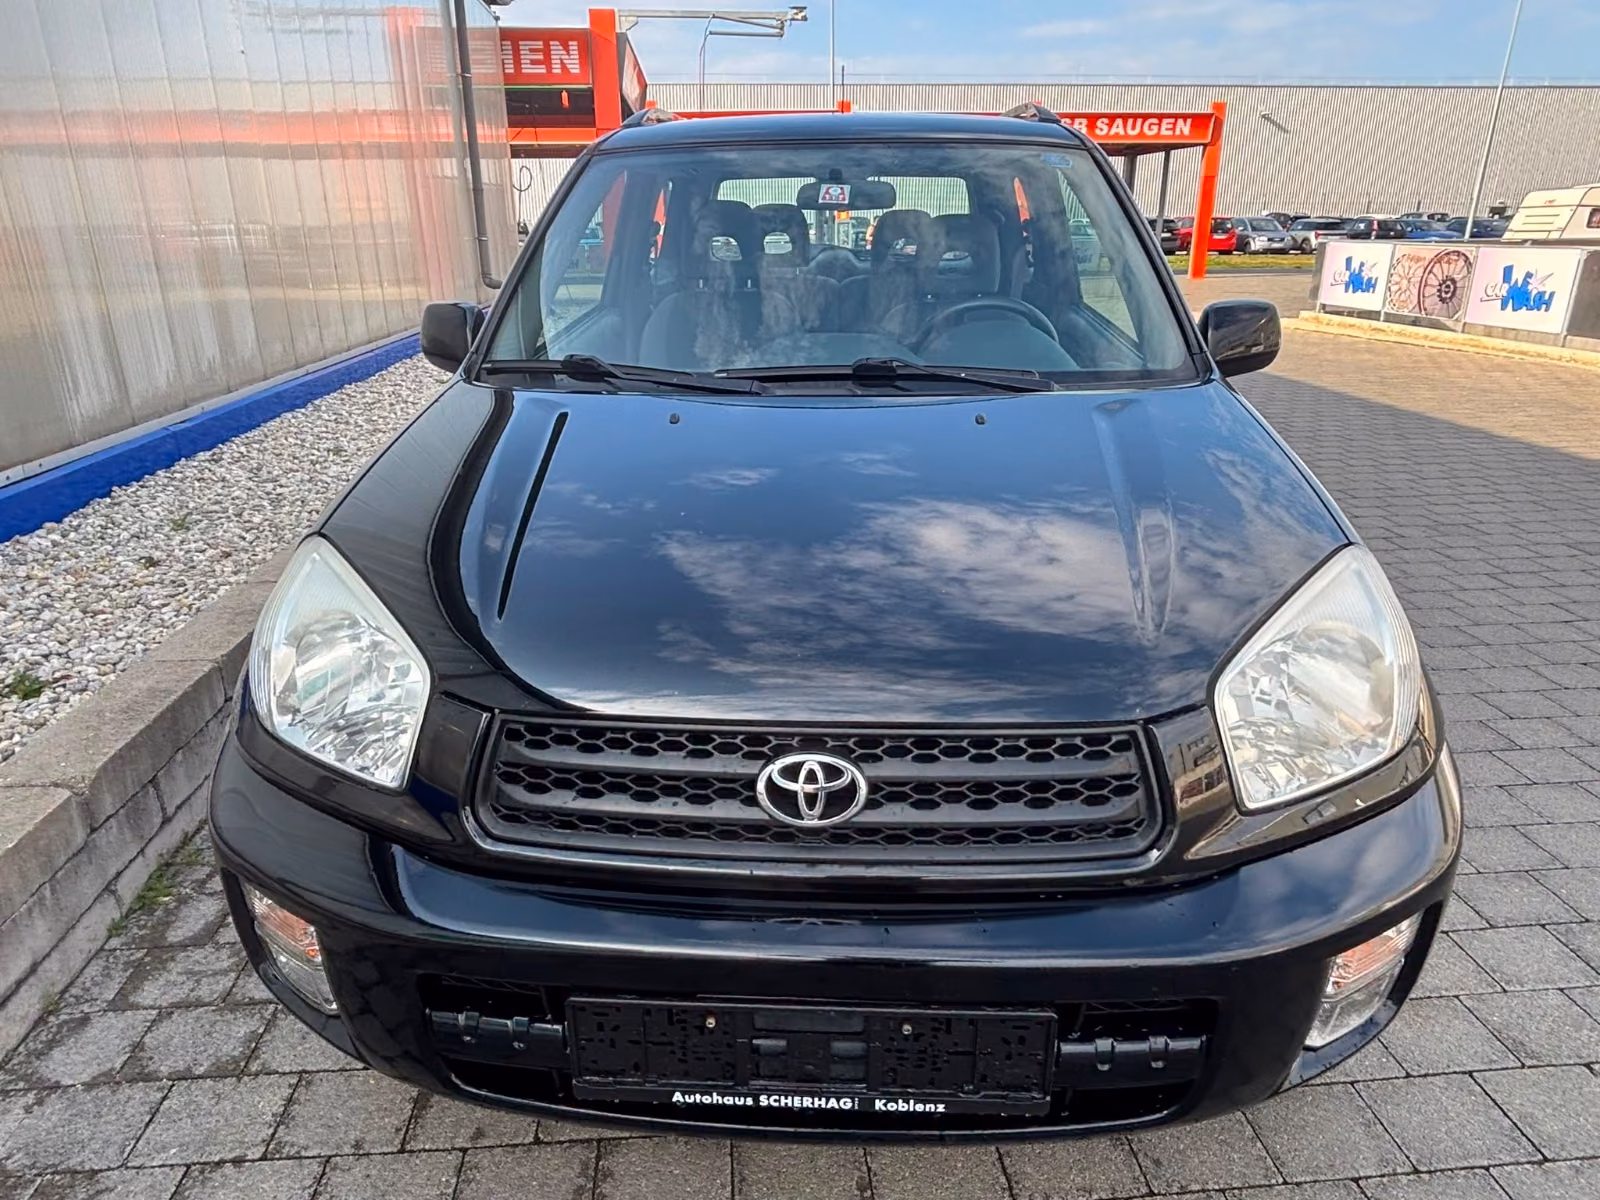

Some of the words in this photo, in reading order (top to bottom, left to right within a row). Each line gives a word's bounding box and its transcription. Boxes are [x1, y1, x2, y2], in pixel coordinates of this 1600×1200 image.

[1095, 117, 1193, 136] SAUGEN
[671, 1091, 754, 1106] Autohaus
[874, 1098, 946, 1112] Koblenz
